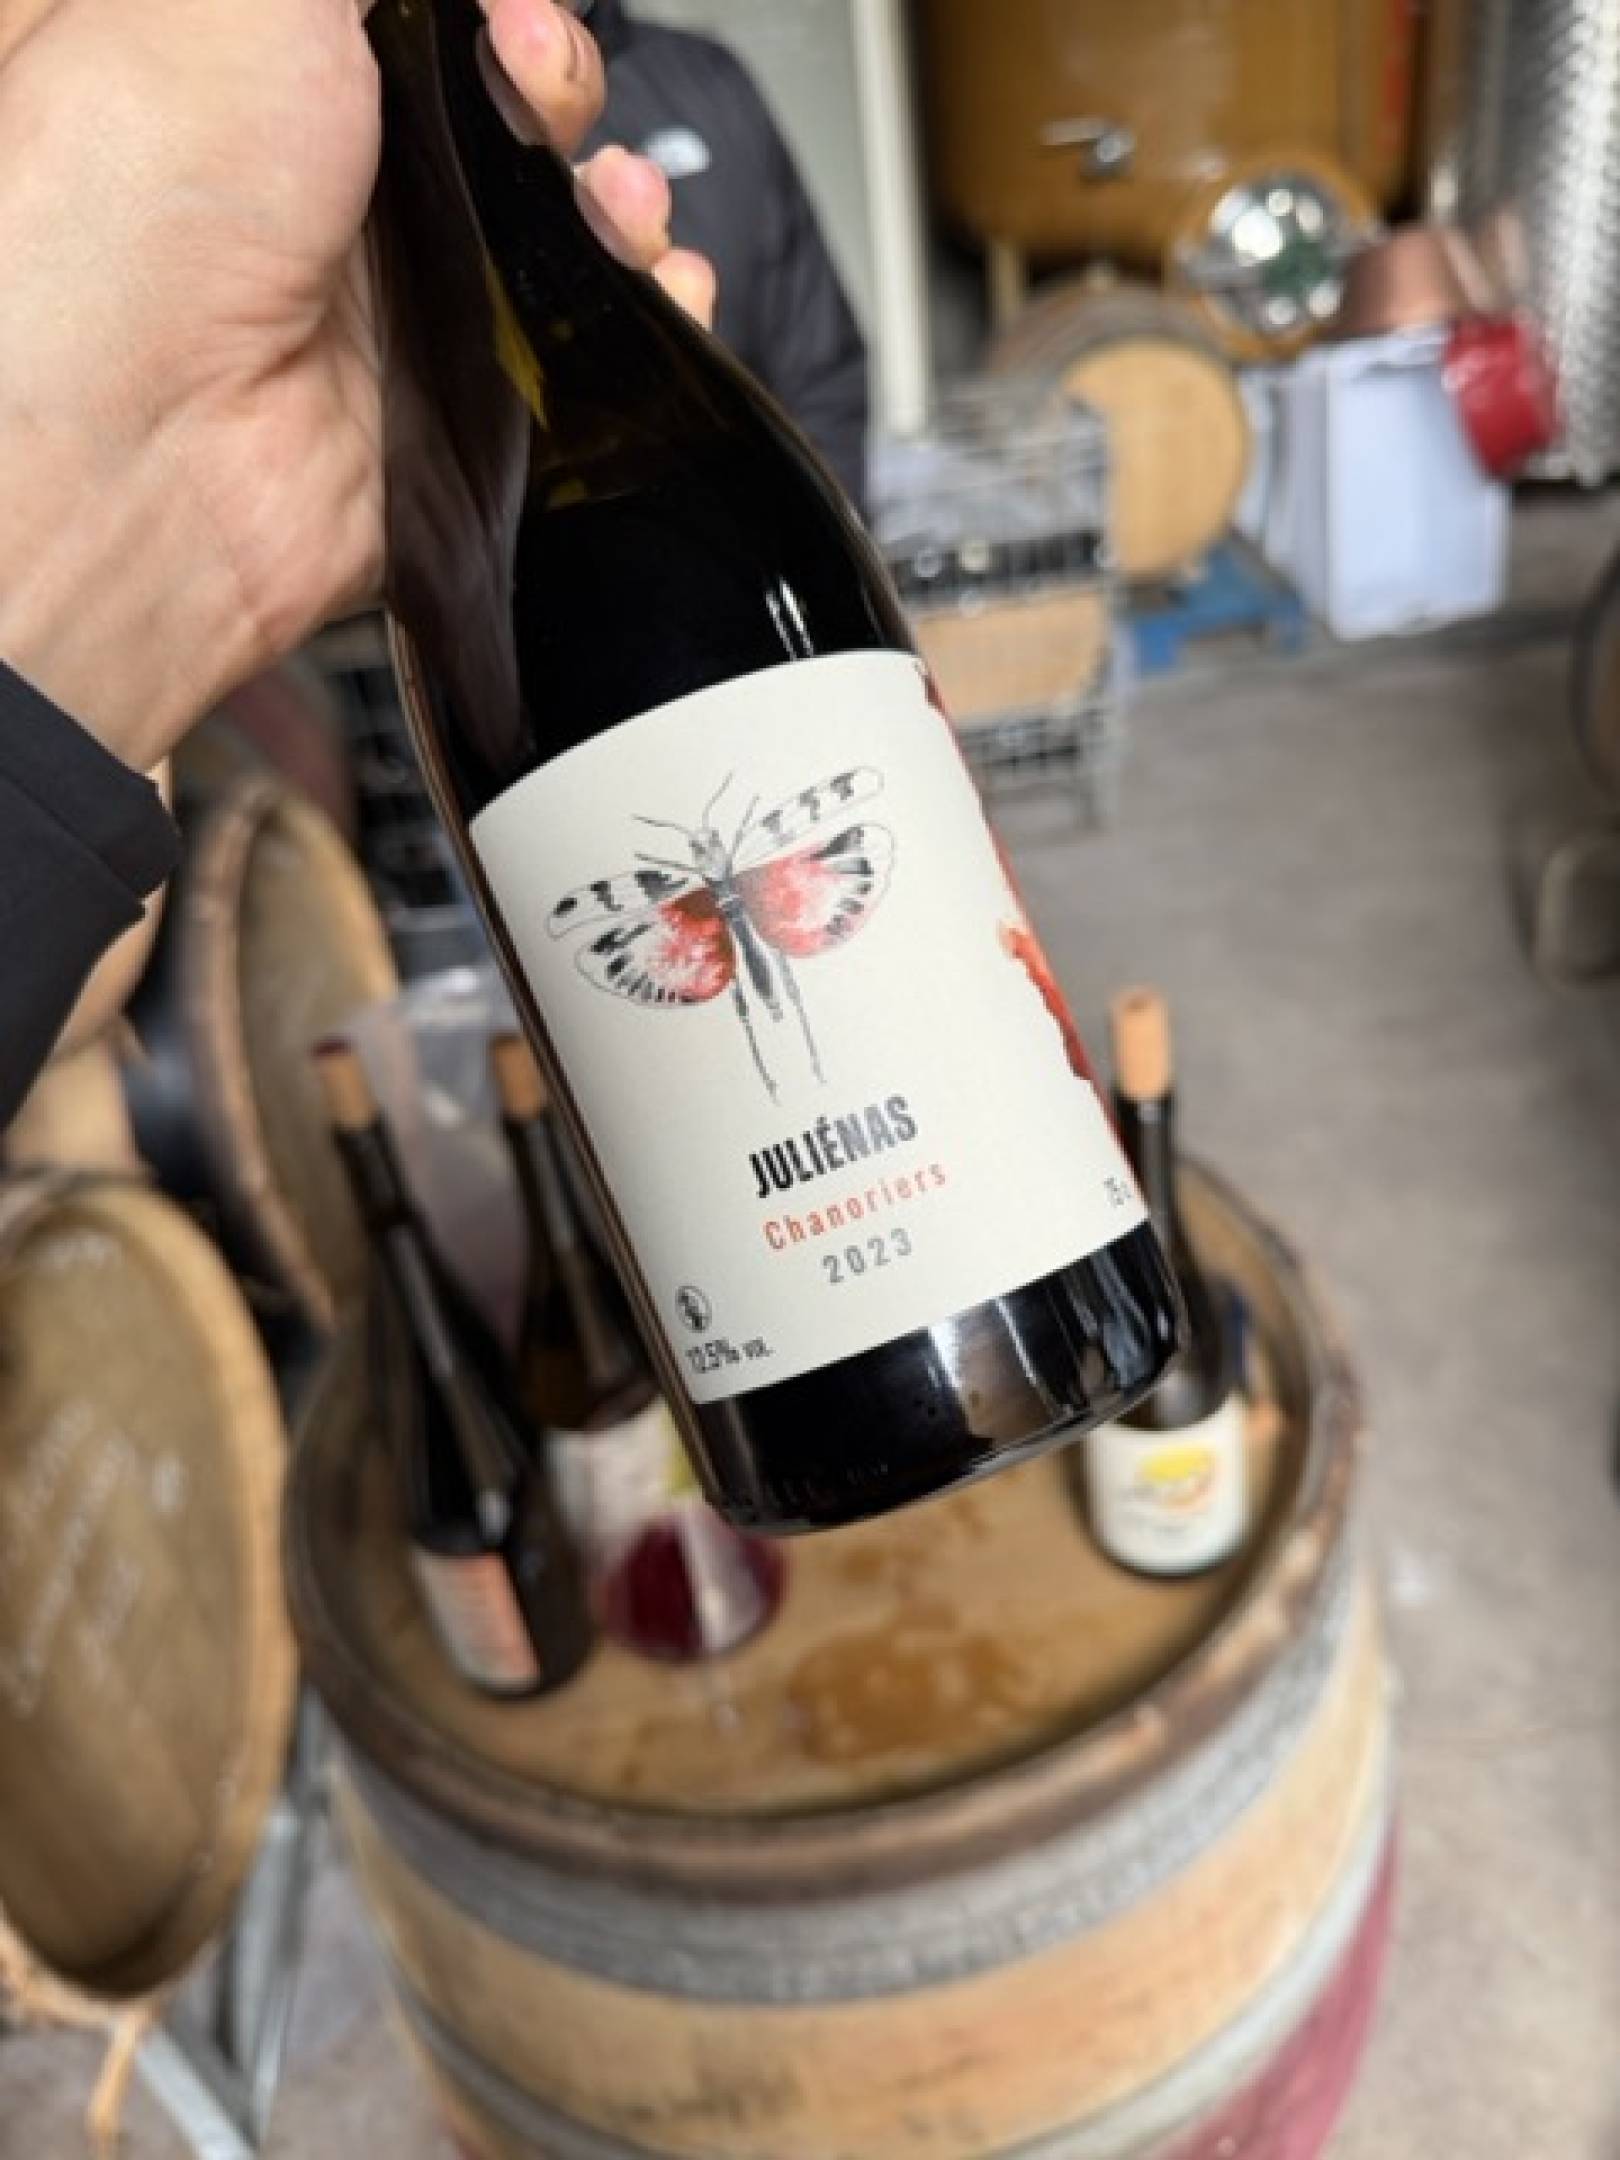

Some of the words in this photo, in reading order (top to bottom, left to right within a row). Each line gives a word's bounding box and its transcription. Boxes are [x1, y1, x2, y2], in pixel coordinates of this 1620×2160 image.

[749, 1096, 918, 1199] JULIÉNAS
[763, 1164, 948, 1251] Chanoriers
[822, 1228, 913, 1284] 2023
